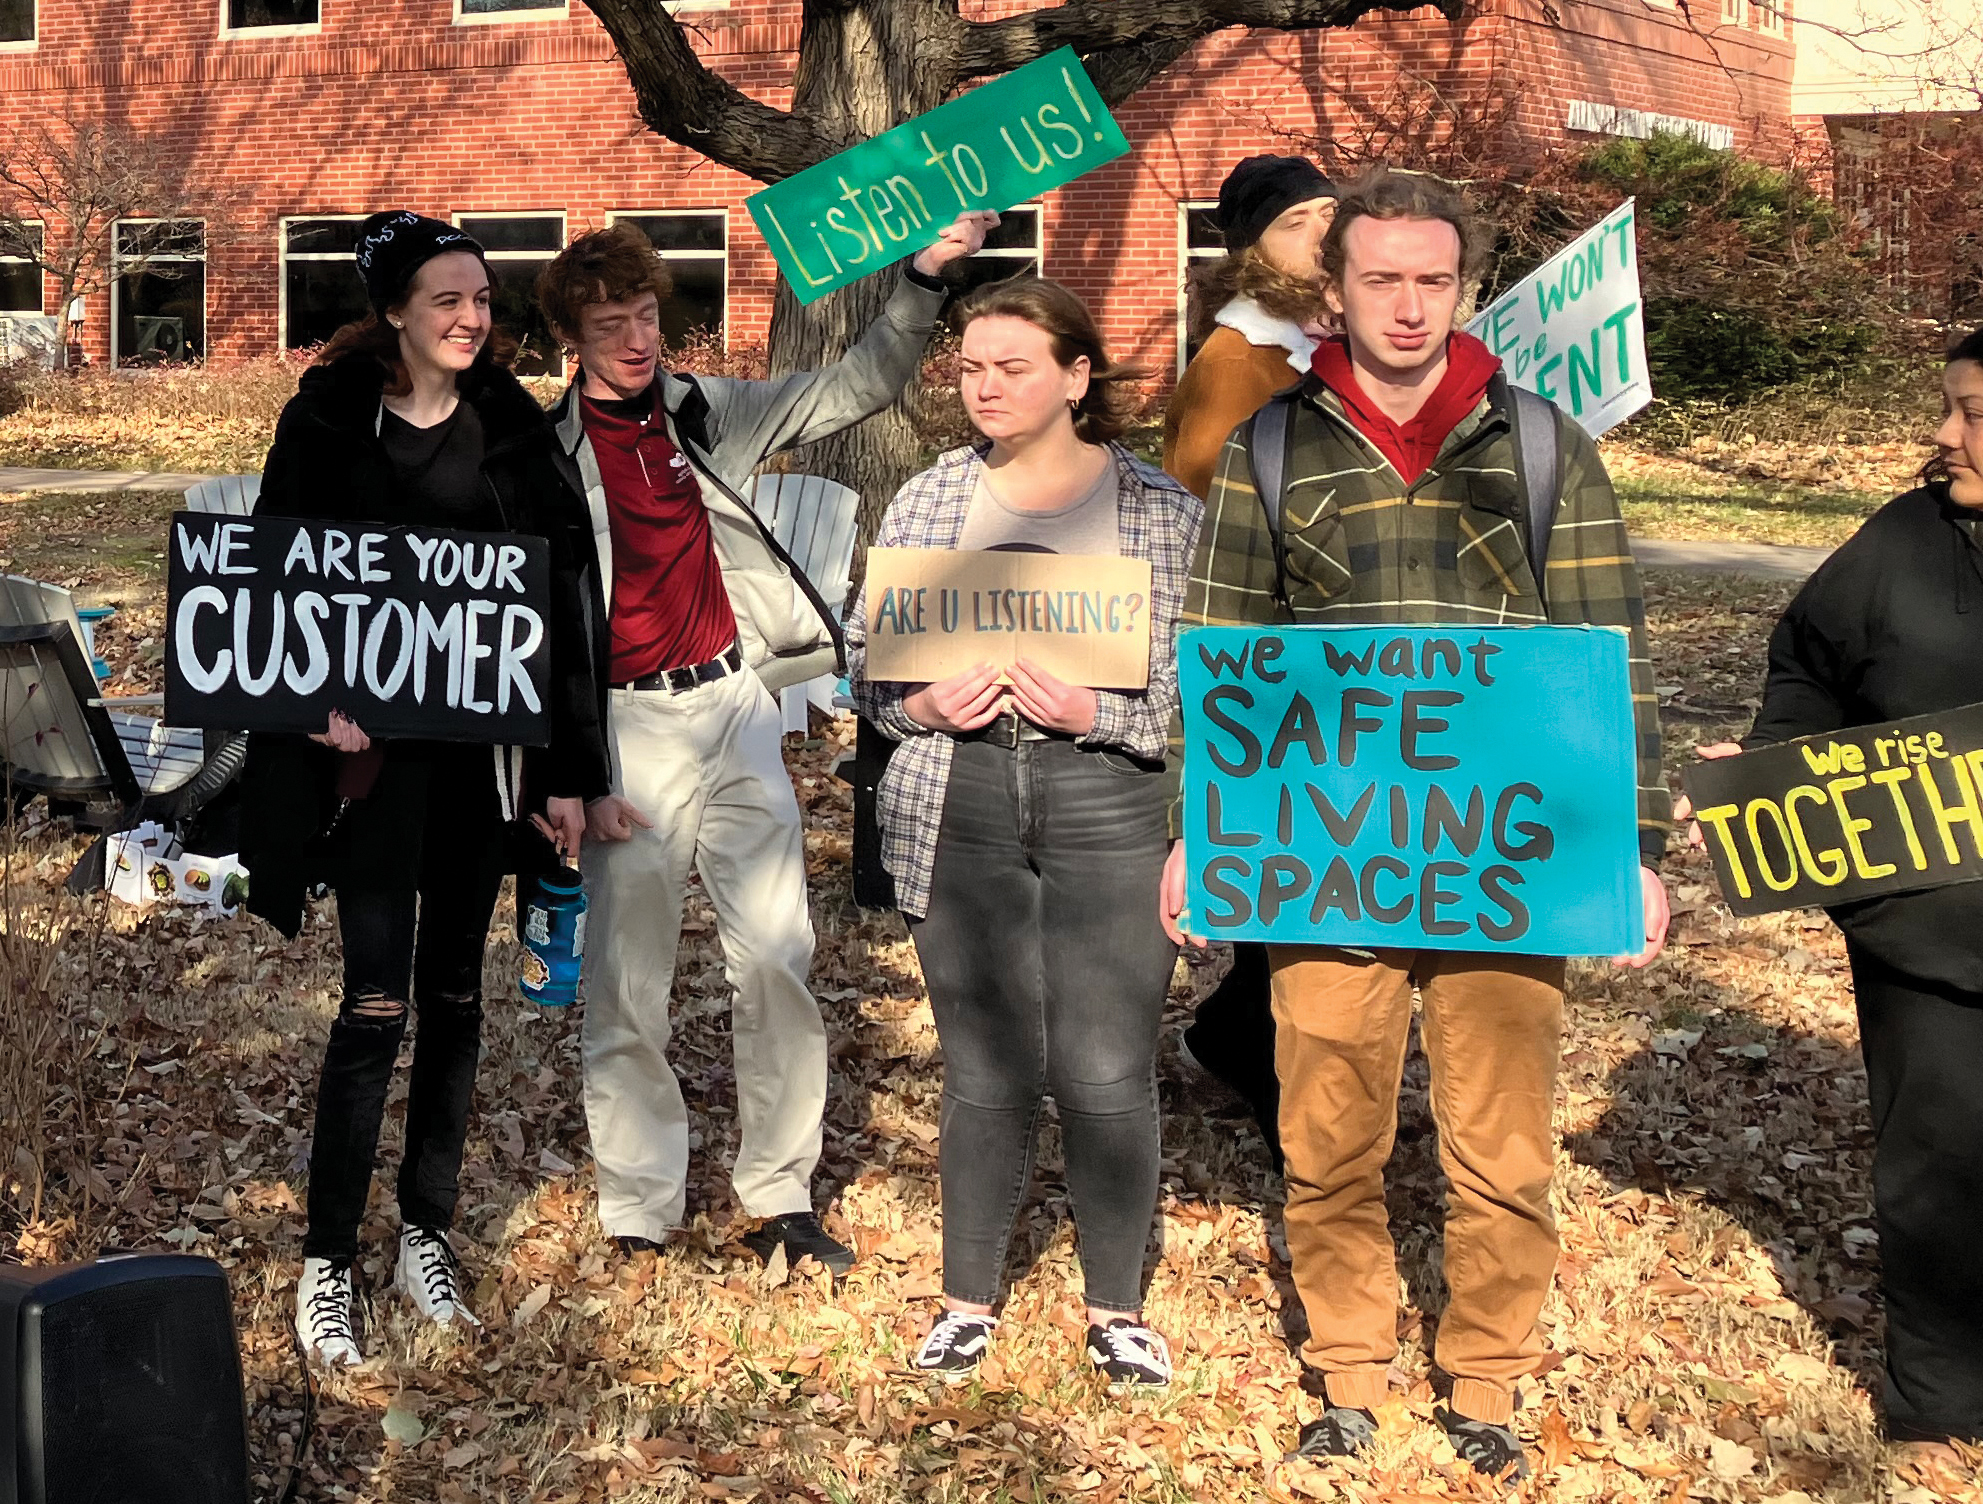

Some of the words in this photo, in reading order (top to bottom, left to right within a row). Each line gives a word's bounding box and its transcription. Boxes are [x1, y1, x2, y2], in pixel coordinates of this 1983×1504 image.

[765, 176, 933, 289] Listen
[921, 131, 989, 209] to
[1000, 67, 1104, 175] us!
[1482, 296, 1521, 357] E
[1536, 214, 1633, 324] WON'T
[1515, 332, 1547, 380] be
[177, 522, 259, 575] WE
[284, 526, 392, 584] ARE
[405, 533, 527, 594] YOUR
[175, 585, 544, 716] CUSTOMER
[873, 586, 927, 635] ARE
[940, 588, 959, 633] U
[973, 588, 1144, 634] LISTENING?
[1199, 636, 1287, 684] we
[1322, 636, 1503, 687] want
[1202, 684, 1466, 778] SAFE
[1874, 729, 1949, 767] rise
[1206, 780, 1555, 862] LIVING
[1202, 854, 1530, 942] SPACES
